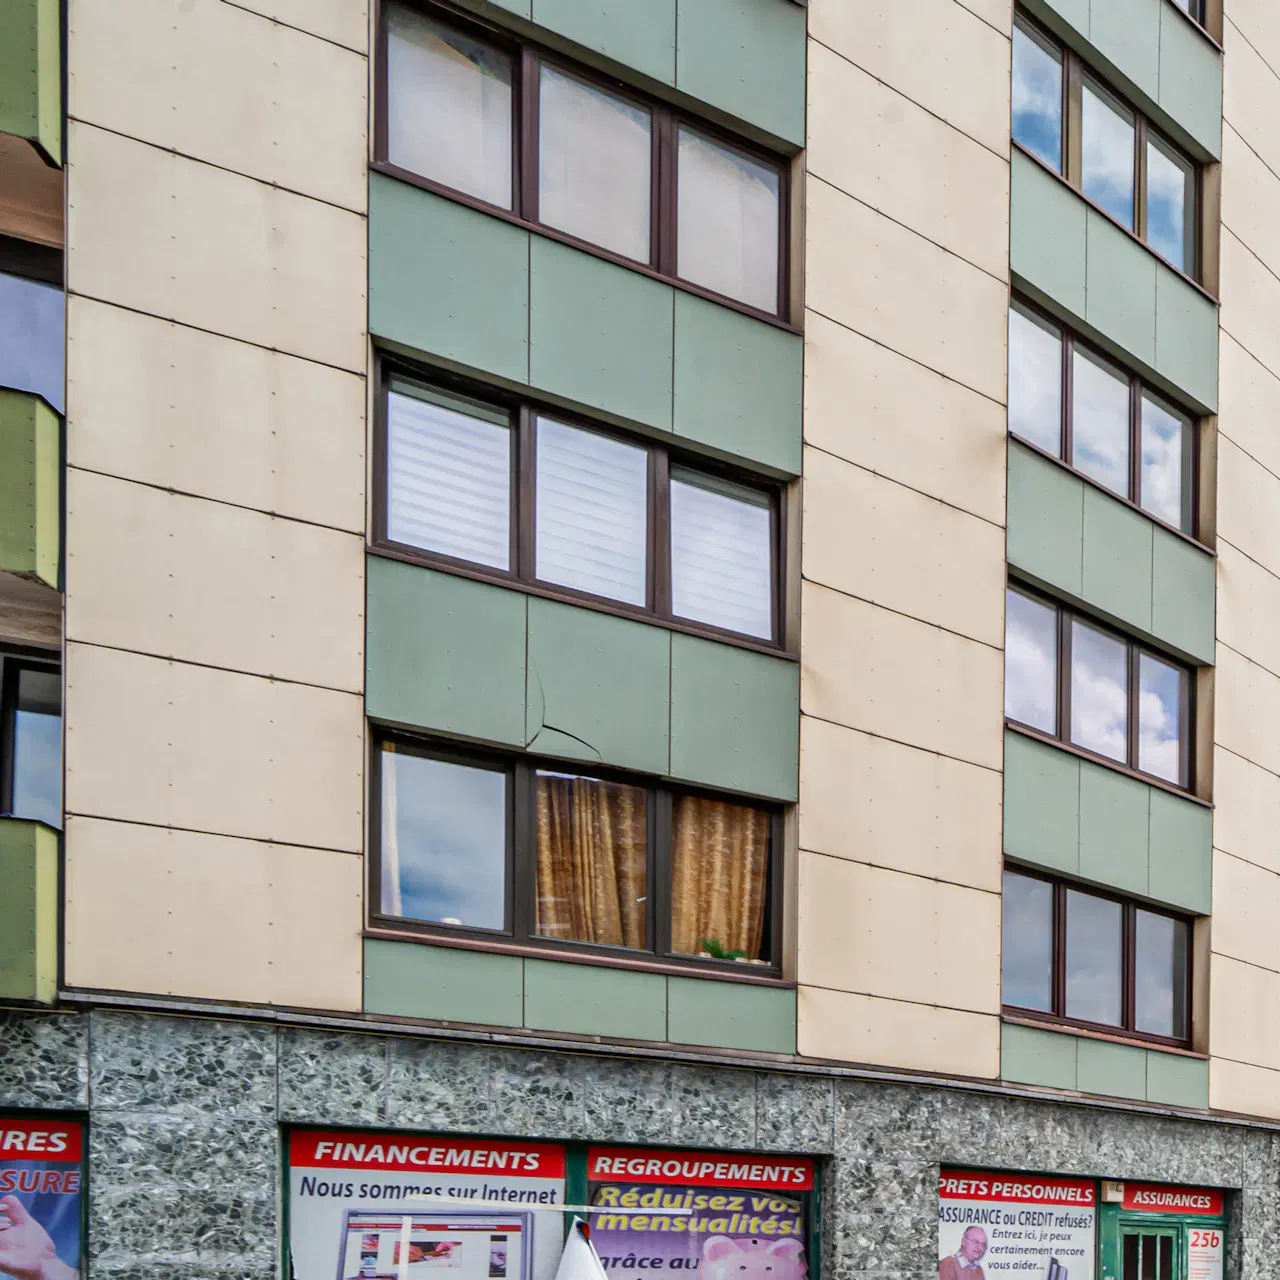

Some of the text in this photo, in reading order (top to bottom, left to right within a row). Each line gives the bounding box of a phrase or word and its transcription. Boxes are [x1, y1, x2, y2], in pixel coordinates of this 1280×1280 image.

[314, 1141, 540, 1171] FINANCEMENTS
[594, 1156, 806, 1183] REGROUPEMENTS
[300, 1176, 557, 1205] Nous sommes sur Internet
[597, 1186, 801, 1214] Réduisez vos
[938, 1178, 1093, 1202] PRETS PERSONNELS
[1133, 1191, 1211, 1208] ASSURANCES
[596, 1213, 802, 1235] mensualités!
[939, 1206, 1093, 1229] ASSURANCE ou CREDIT refusés?
[992, 1228, 1072, 1244] Entrez ici, je peux
[1190, 1231, 1219, 1248] 25b
[989, 1245, 1085, 1257] certainement encore
[669, 1257, 699, 1269] au
[988, 1261, 1011, 1270] vous
